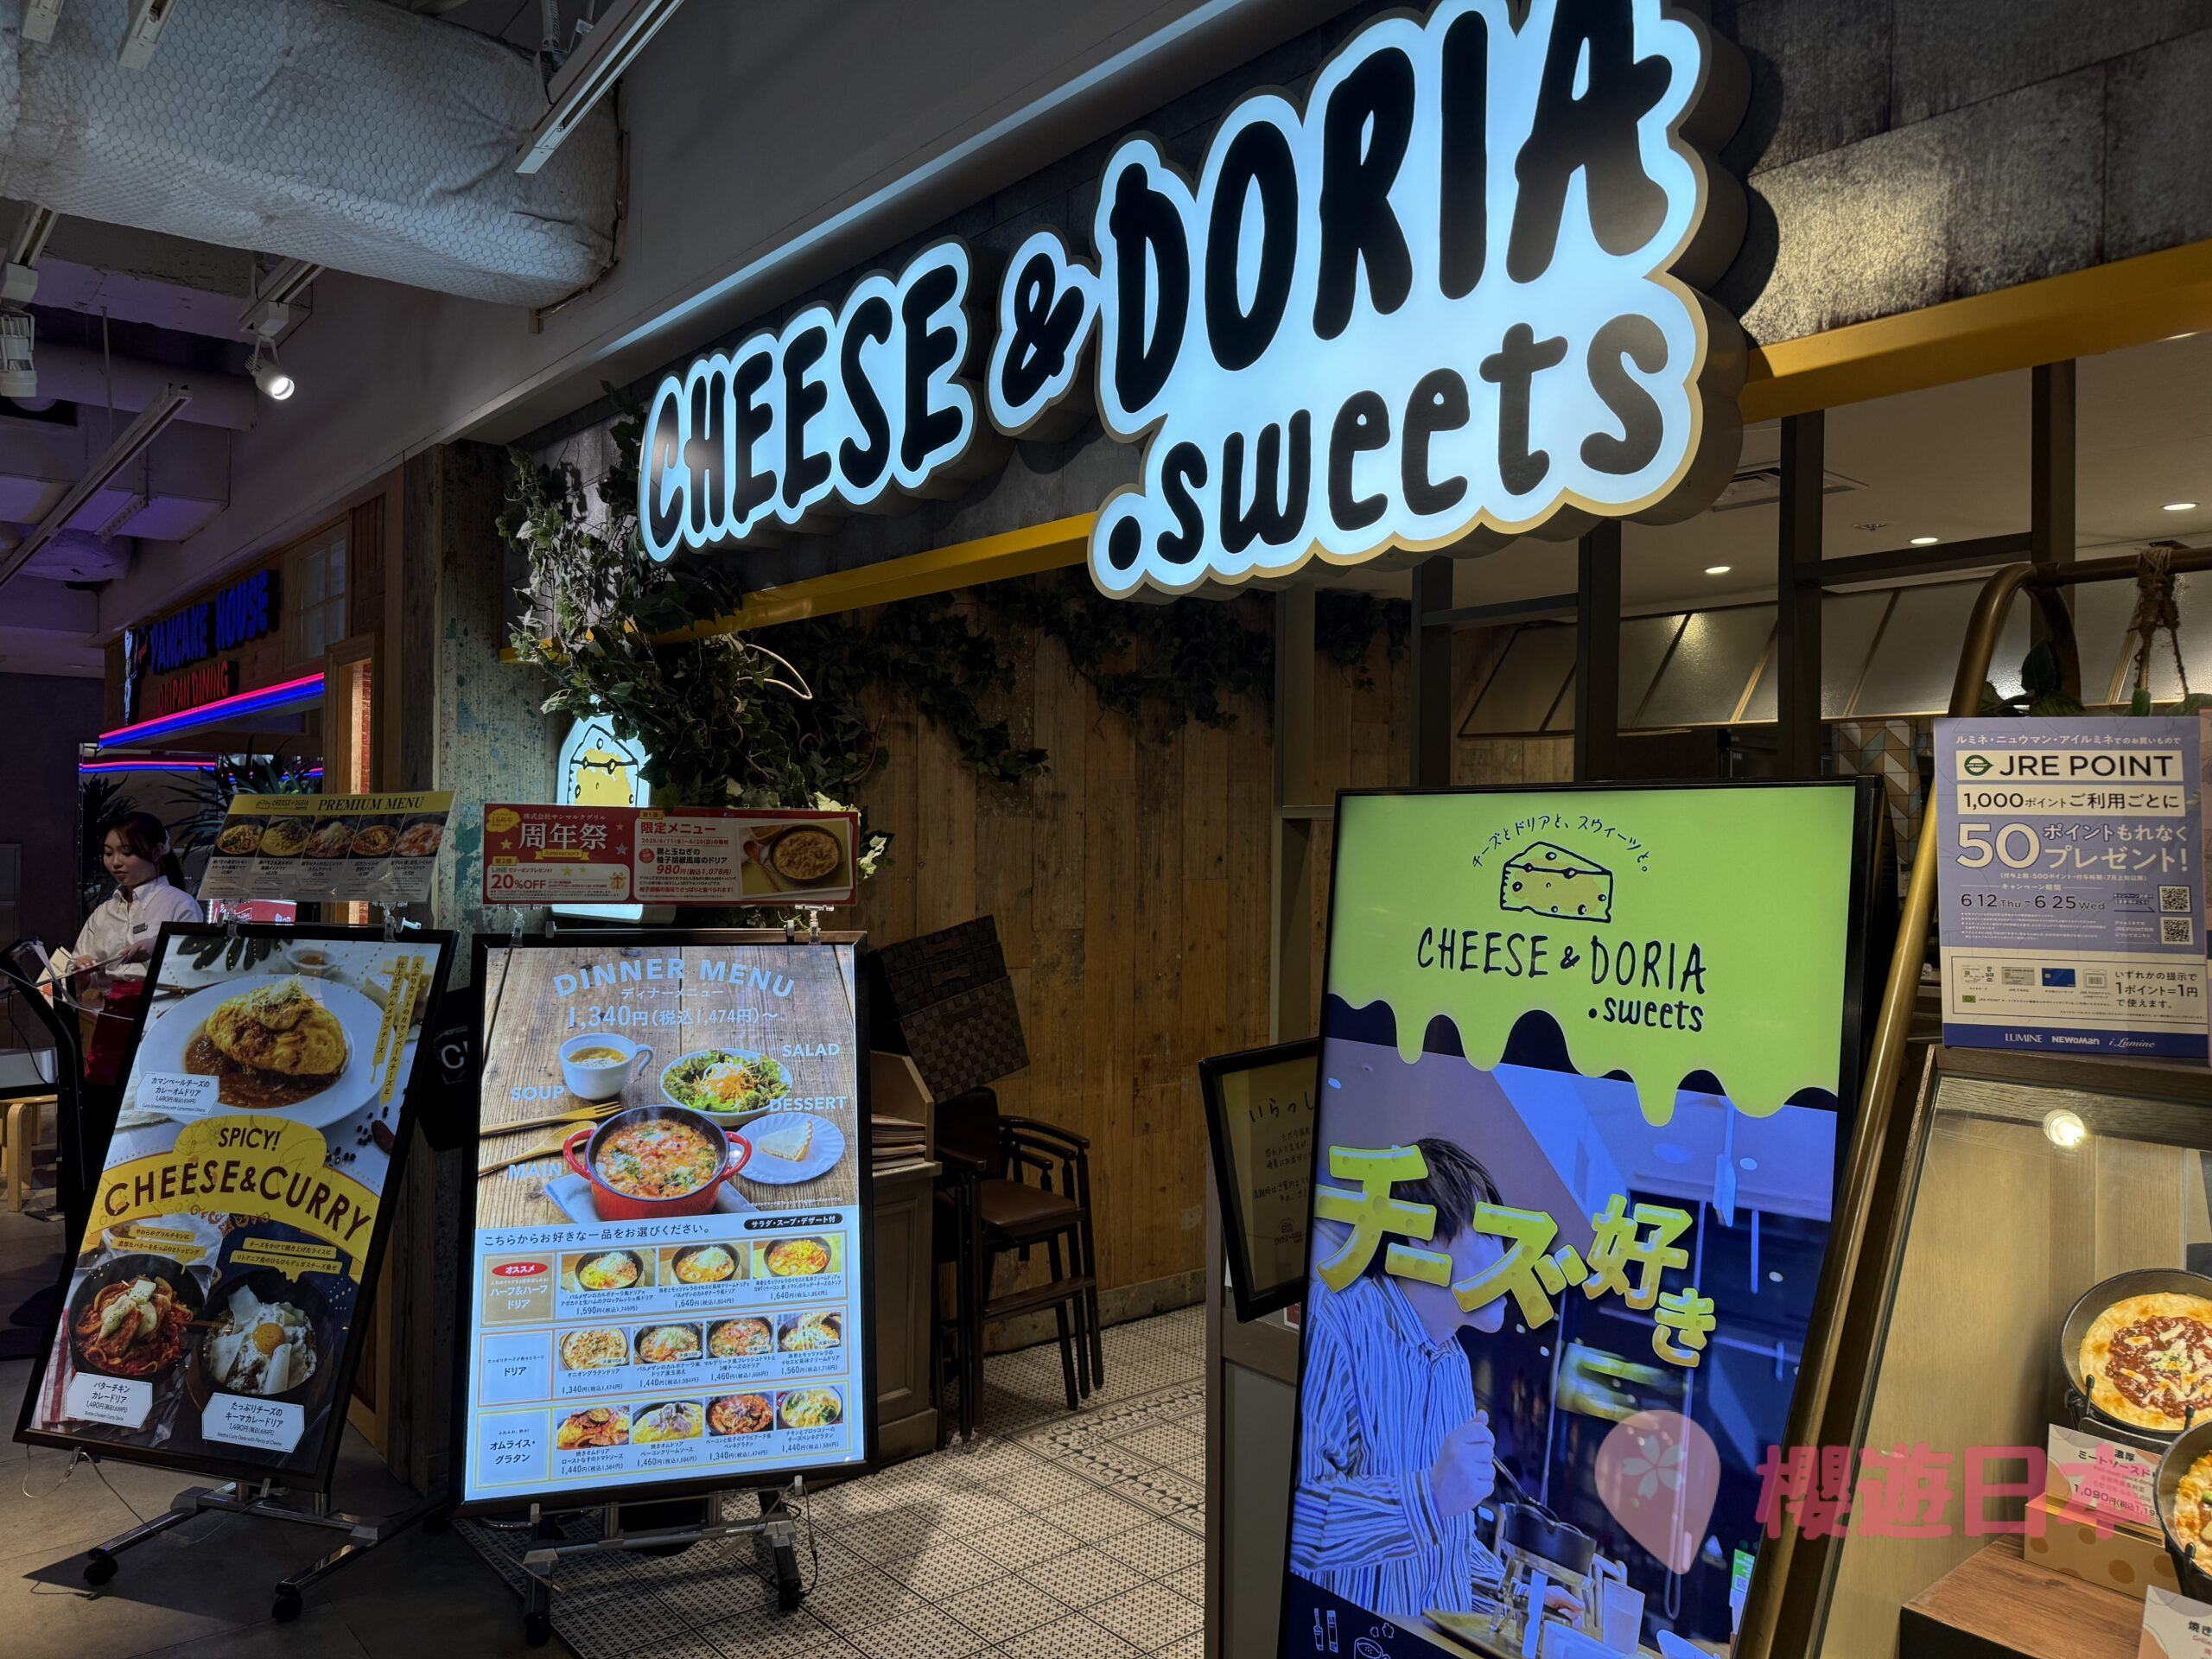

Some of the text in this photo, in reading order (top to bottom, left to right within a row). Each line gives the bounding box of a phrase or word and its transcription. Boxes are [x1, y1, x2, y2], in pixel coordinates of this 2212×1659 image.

[649, 0, 1673, 550] CHEESE & DORIA
[150, 569, 268, 675] PANCAKE HOUSE
[192, 661, 229, 707] DINING
[1956, 734, 2181, 746] ルミネ・ニュウマン・アイルミネでのお買いもので
[1999, 755, 2173, 777] JRE POINT
[318, 797, 425, 811] PREMIUM MENU
[1963, 791, 2179, 810] 1,000ポイントご利用ごとに
[524, 812, 607, 821] 株式会社サンマルクグリル
[641, 822, 715, 834] 限定メニュー
[2043, 823, 2187, 842] ポイントもれなく
[519, 823, 607, 850] 周年祭
[1471, 812, 1650, 873] チーズとドリアと、スウィーツと。
[1955, 822, 2041, 869] 50
[2044, 843, 2188, 873] プレゼント!
[657, 864, 732, 875] 980円(税込1,078円)
[491, 874, 546, 890] 20%OFF
[2000, 899, 2021, 909] Thu
[2078, 901, 2106, 910] Wed
[1416, 926, 1707, 995] CHEESE & DORIA
[553, 957, 795, 998] DINNER MENU
[2114, 969, 2198, 982] いずれかの提示で
[620, 987, 724, 1001] ディナーメニュー
[2115, 982, 2198, 999] 1ポイント=1円
[377, 961, 405, 1053] 仕上げにパルメザンチーズ
[2116, 997, 2172, 1010] で使えます。
[384, 962, 421, 1095] 大ぶりカットのカマンベールチーズと
[2005, 1033, 2043, 1043] LUMINE
[2116, 1036, 2157, 1048] Lumine
[783, 1043, 841, 1058] SALAD
[151, 1077, 210, 1088] カマンベールチーズの
[156, 1086, 201, 1096] カレーオムドリア
[510, 1085, 565, 1102] SOUP
[769, 1096, 847, 1113] DESSERT
[217, 1127, 281, 1152] SPICY!
[507, 1163, 563, 1179] MAIN
[105, 1159, 372, 1242] CHEESE&CURRY
[751, 1215, 836, 1229] サラダ・スープ・デザート付
[136, 1228, 190, 1240] やわらかグリルチキンに
[484, 1224, 710, 1247] こちらからお好きな一品をお選びください。
[118, 1239, 201, 1255] 濃厚なバターをたっぷりとトッピング
[249, 1240, 332, 1256] チーズをかけて焼き上げたライスに
[1314, 1145, 1717, 1368] チーズ好き
[505, 1264, 536, 1274] オススメ
[490, 1285, 549, 1298] ハーフ&ハーフ
[507, 1299, 531, 1311] ドリア
[504, 1366, 527, 1377] ドリア
[567, 1368, 621, 1379] オニオングラタンドリア
[93, 1382, 130, 1395] バターチキン
[92, 1392, 127, 1403] カレードリア
[231, 1401, 283, 1417] たっぷりチーズの
[225, 1411, 284, 1427] キーマカレードリア
[786, 1427, 836, 1438] チキンとブロッコリーの
[640, 1446, 695, 1457] ベーコンクリームソース
[651, 1441, 684, 1450] 焼きオムドリア
[495, 1453, 531, 1465] グラタン
[562, 1453, 624, 1465] ローストなすのトマトソース
[575, 1448, 610, 1458] 焼きオムドリア
[2113, 1448, 2136, 1462] 濃厚
